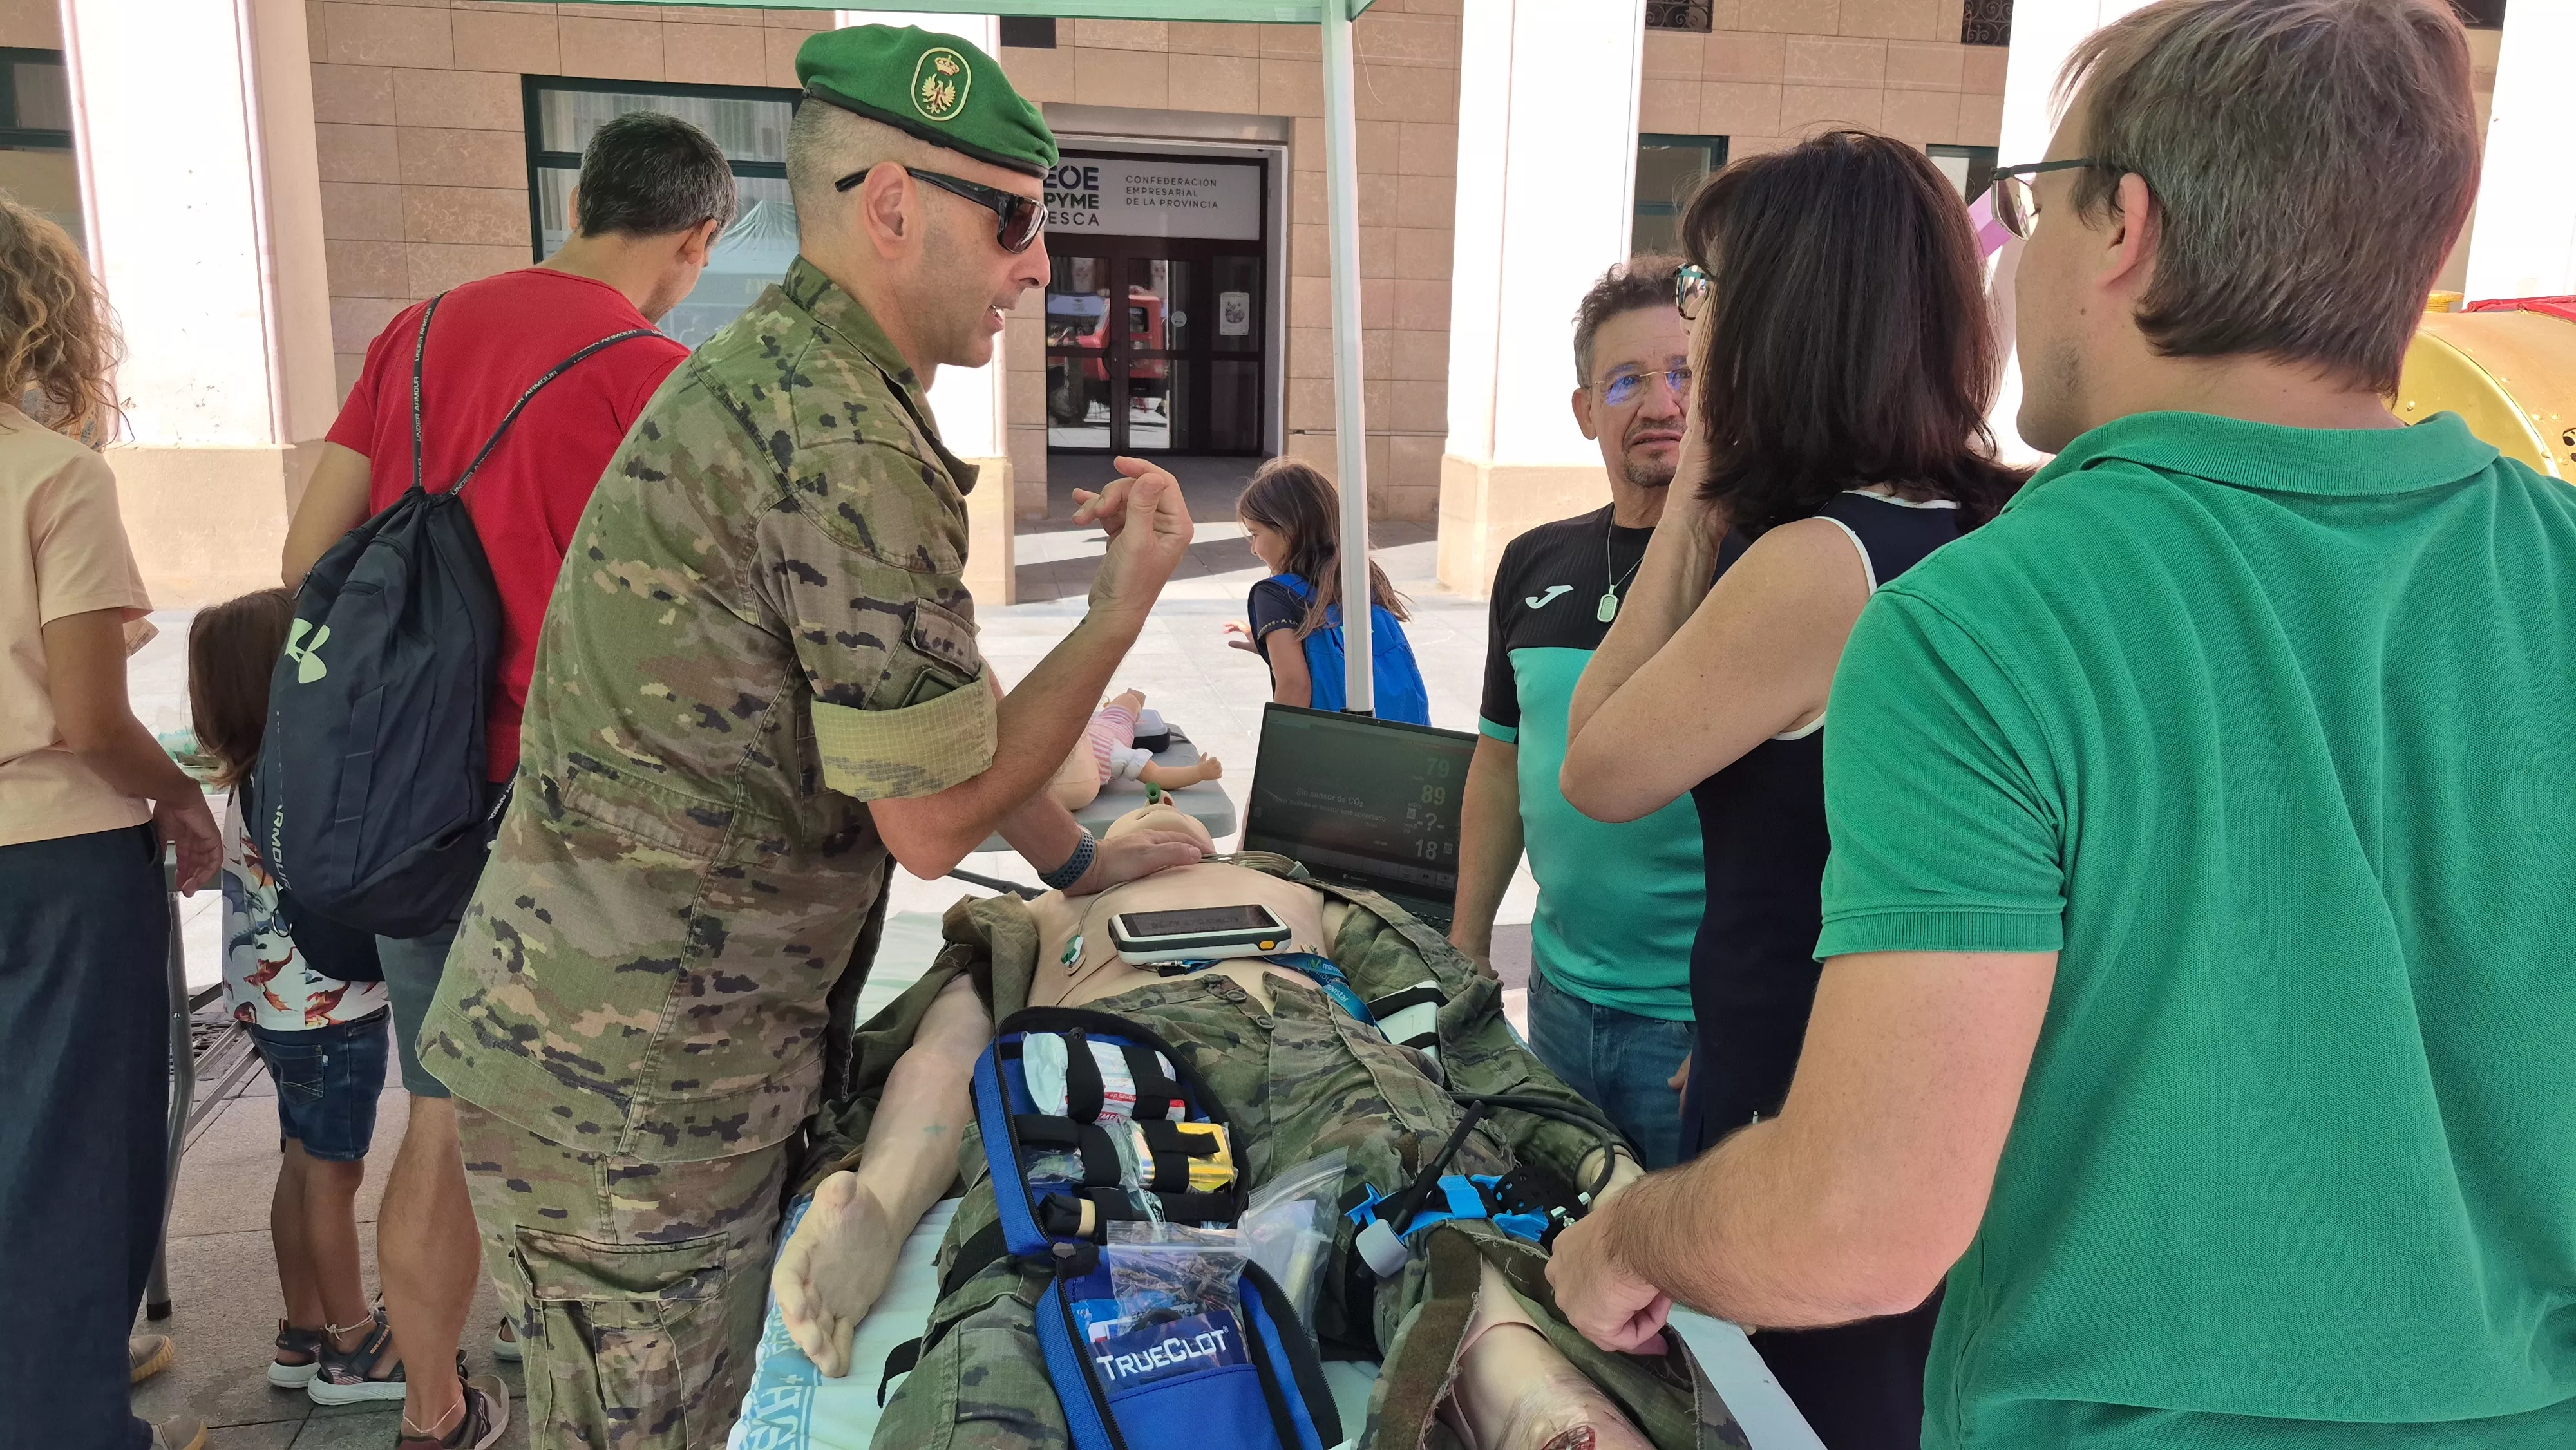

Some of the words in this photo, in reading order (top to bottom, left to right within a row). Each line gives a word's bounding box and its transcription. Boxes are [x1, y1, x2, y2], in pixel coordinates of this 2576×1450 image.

[1126, 175, 1217, 187] CONFEDERACIÓN
[1126, 186, 1199, 197] EMPRESARIAL
[1160, 199, 1218, 209] PROVINCIA
[415, 337, 423, 361] UNDER
[420, 307, 432, 335] ARMOUR
[413, 376, 422, 412] ARMOUR
[524, 370, 558, 398] ARMOUR
[451, 471, 475, 496] UNDER
[1426, 758, 1450, 779] 79
[1421, 784, 1446, 805] 89
[271, 804, 292, 890] RMOUR
[1414, 838, 1438, 861] 18
